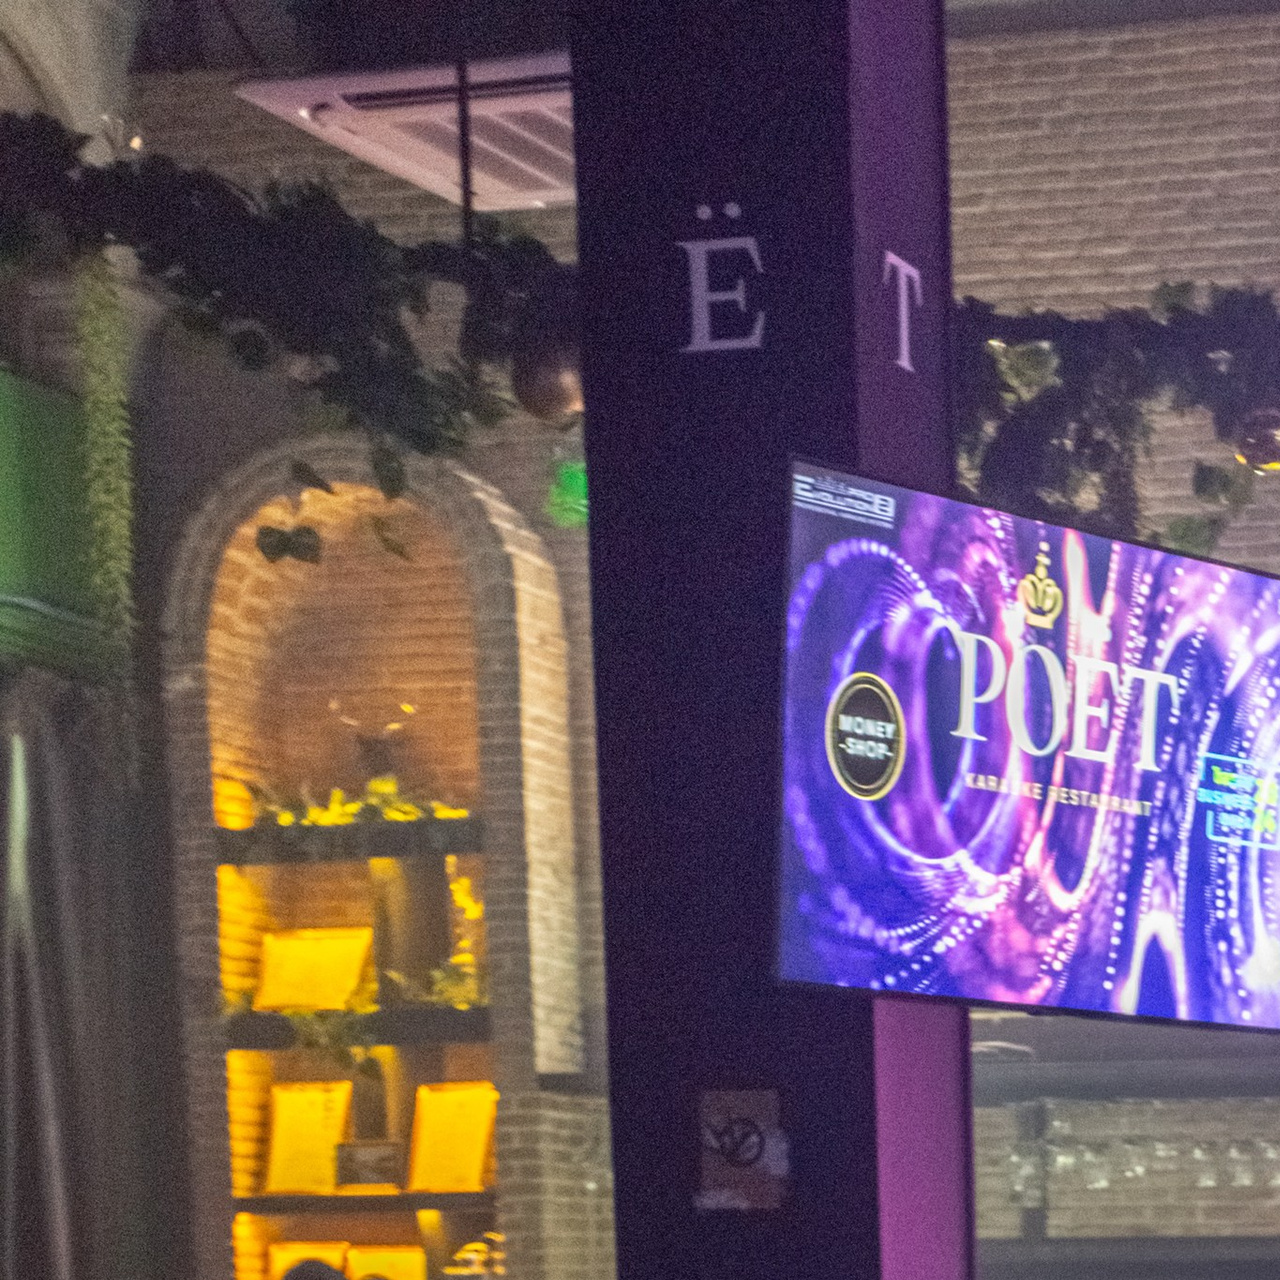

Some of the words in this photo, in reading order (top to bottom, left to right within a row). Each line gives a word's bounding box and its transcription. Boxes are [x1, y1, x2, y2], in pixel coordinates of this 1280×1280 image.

[674, 202, 766, 353] Ë
[882, 250, 924, 372] T
[838, 714, 897, 739] MONEY
[965, 773, 1042, 800] KARAKE
